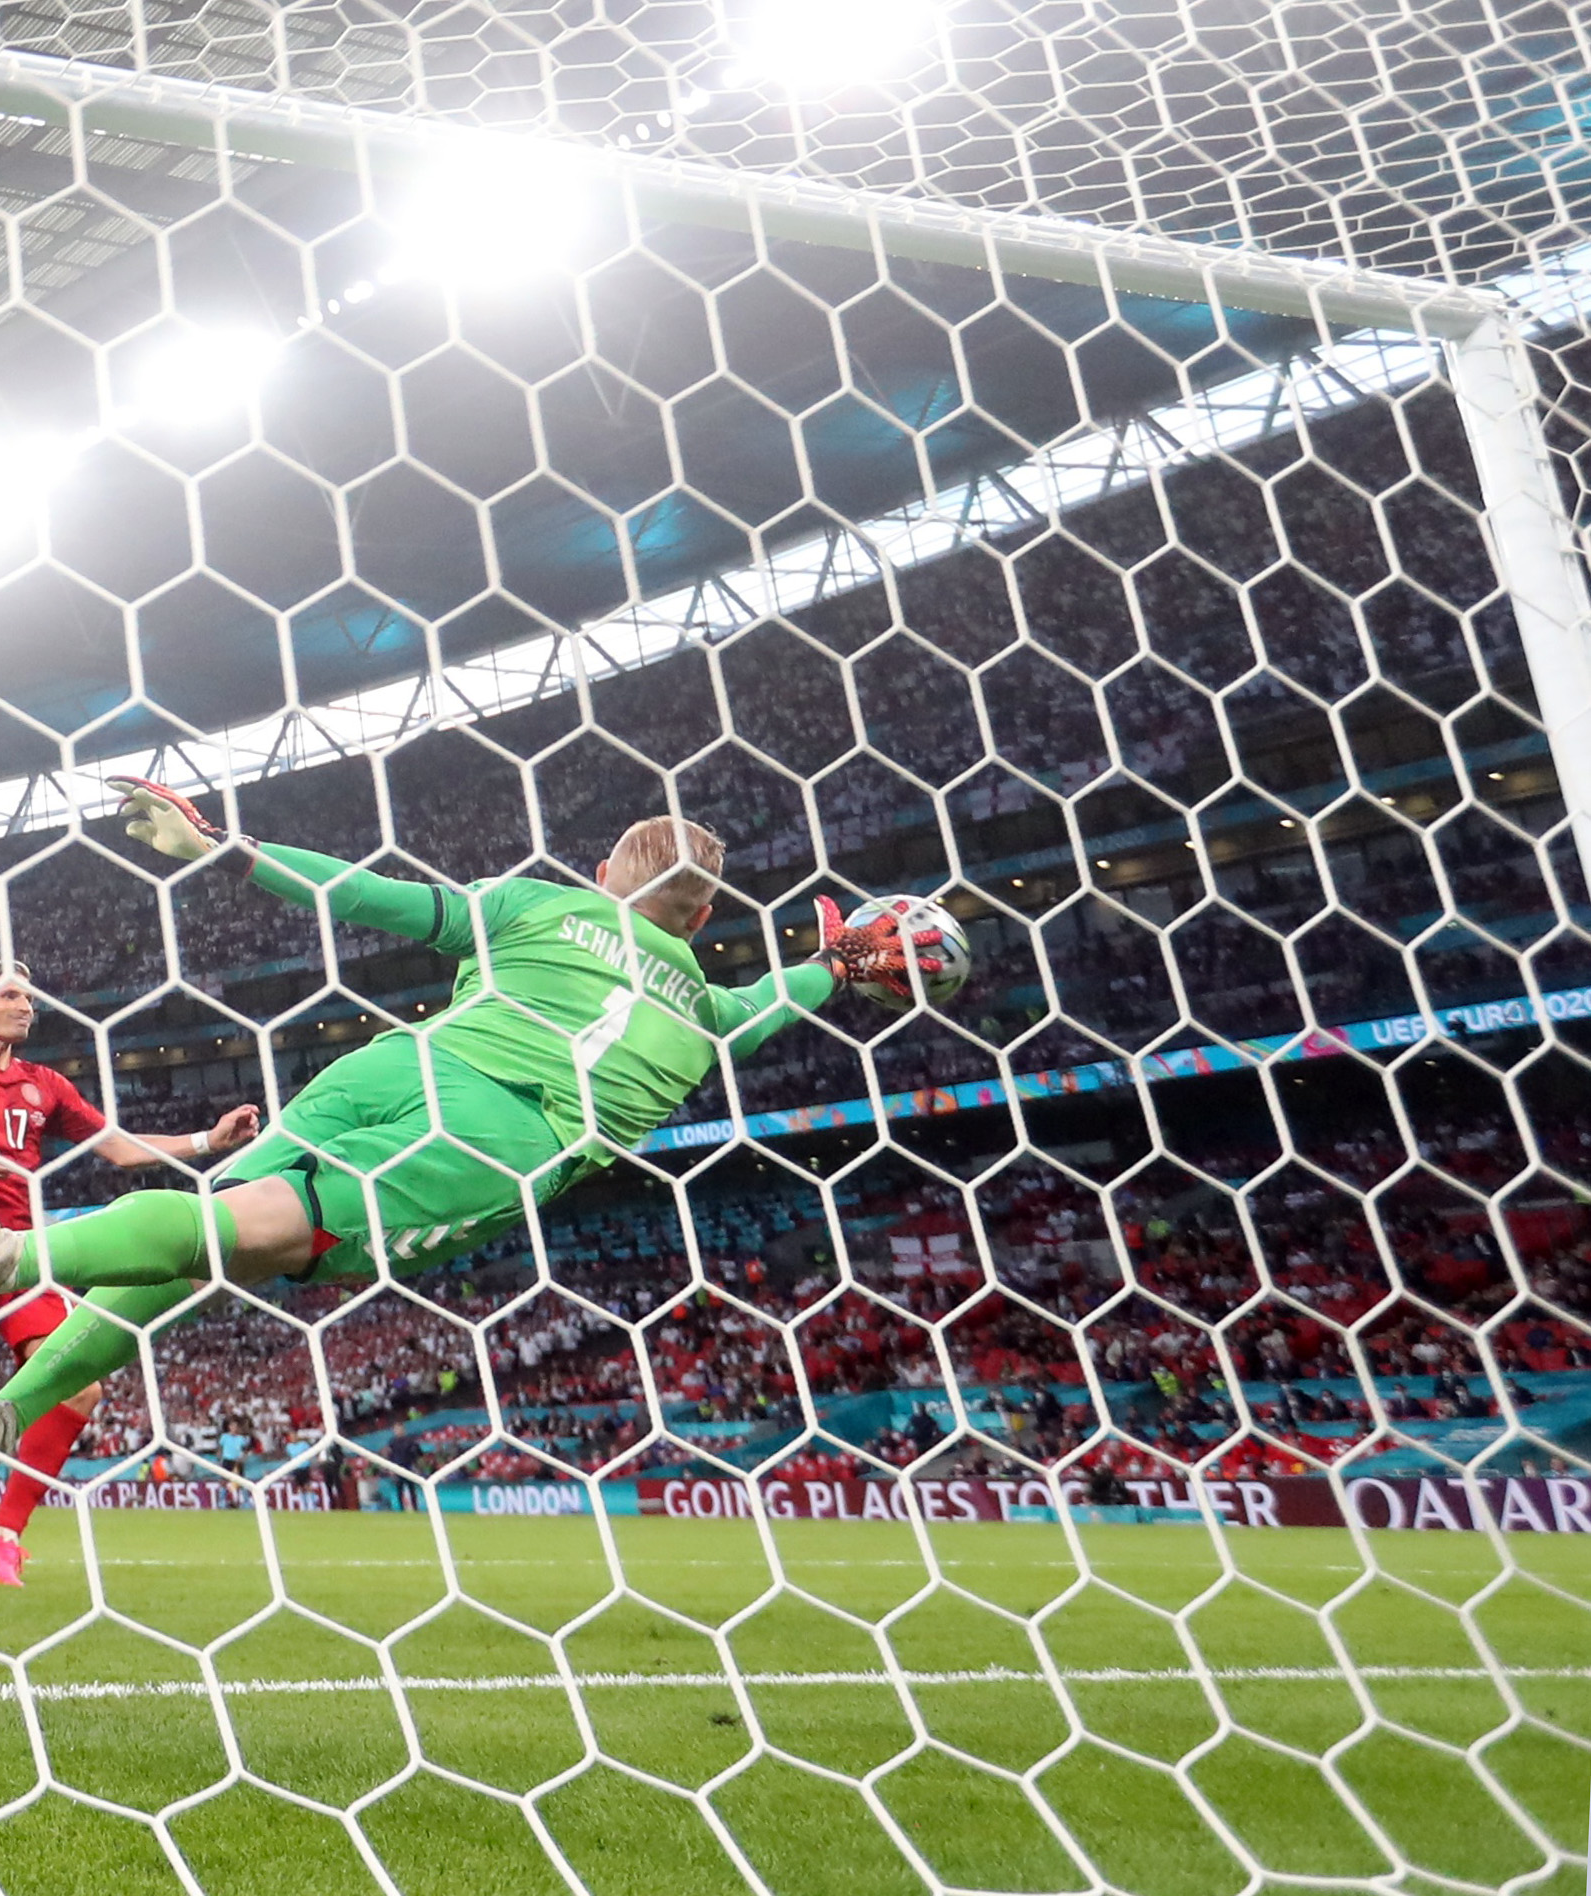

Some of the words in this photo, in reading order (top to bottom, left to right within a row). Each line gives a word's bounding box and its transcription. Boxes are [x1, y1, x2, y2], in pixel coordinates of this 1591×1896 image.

[579, 985, 636, 1070] 1
[4, 1108, 28, 1150] 17
[672, 1121, 735, 1147] LONDO
[118, 1481, 202, 1510] PLACES
[472, 1485, 581, 1515] LONDON
[663, 1480, 796, 1519] GOING
[806, 1480, 978, 1522] PLACES
[1345, 1476, 1591, 1534] QATAR
